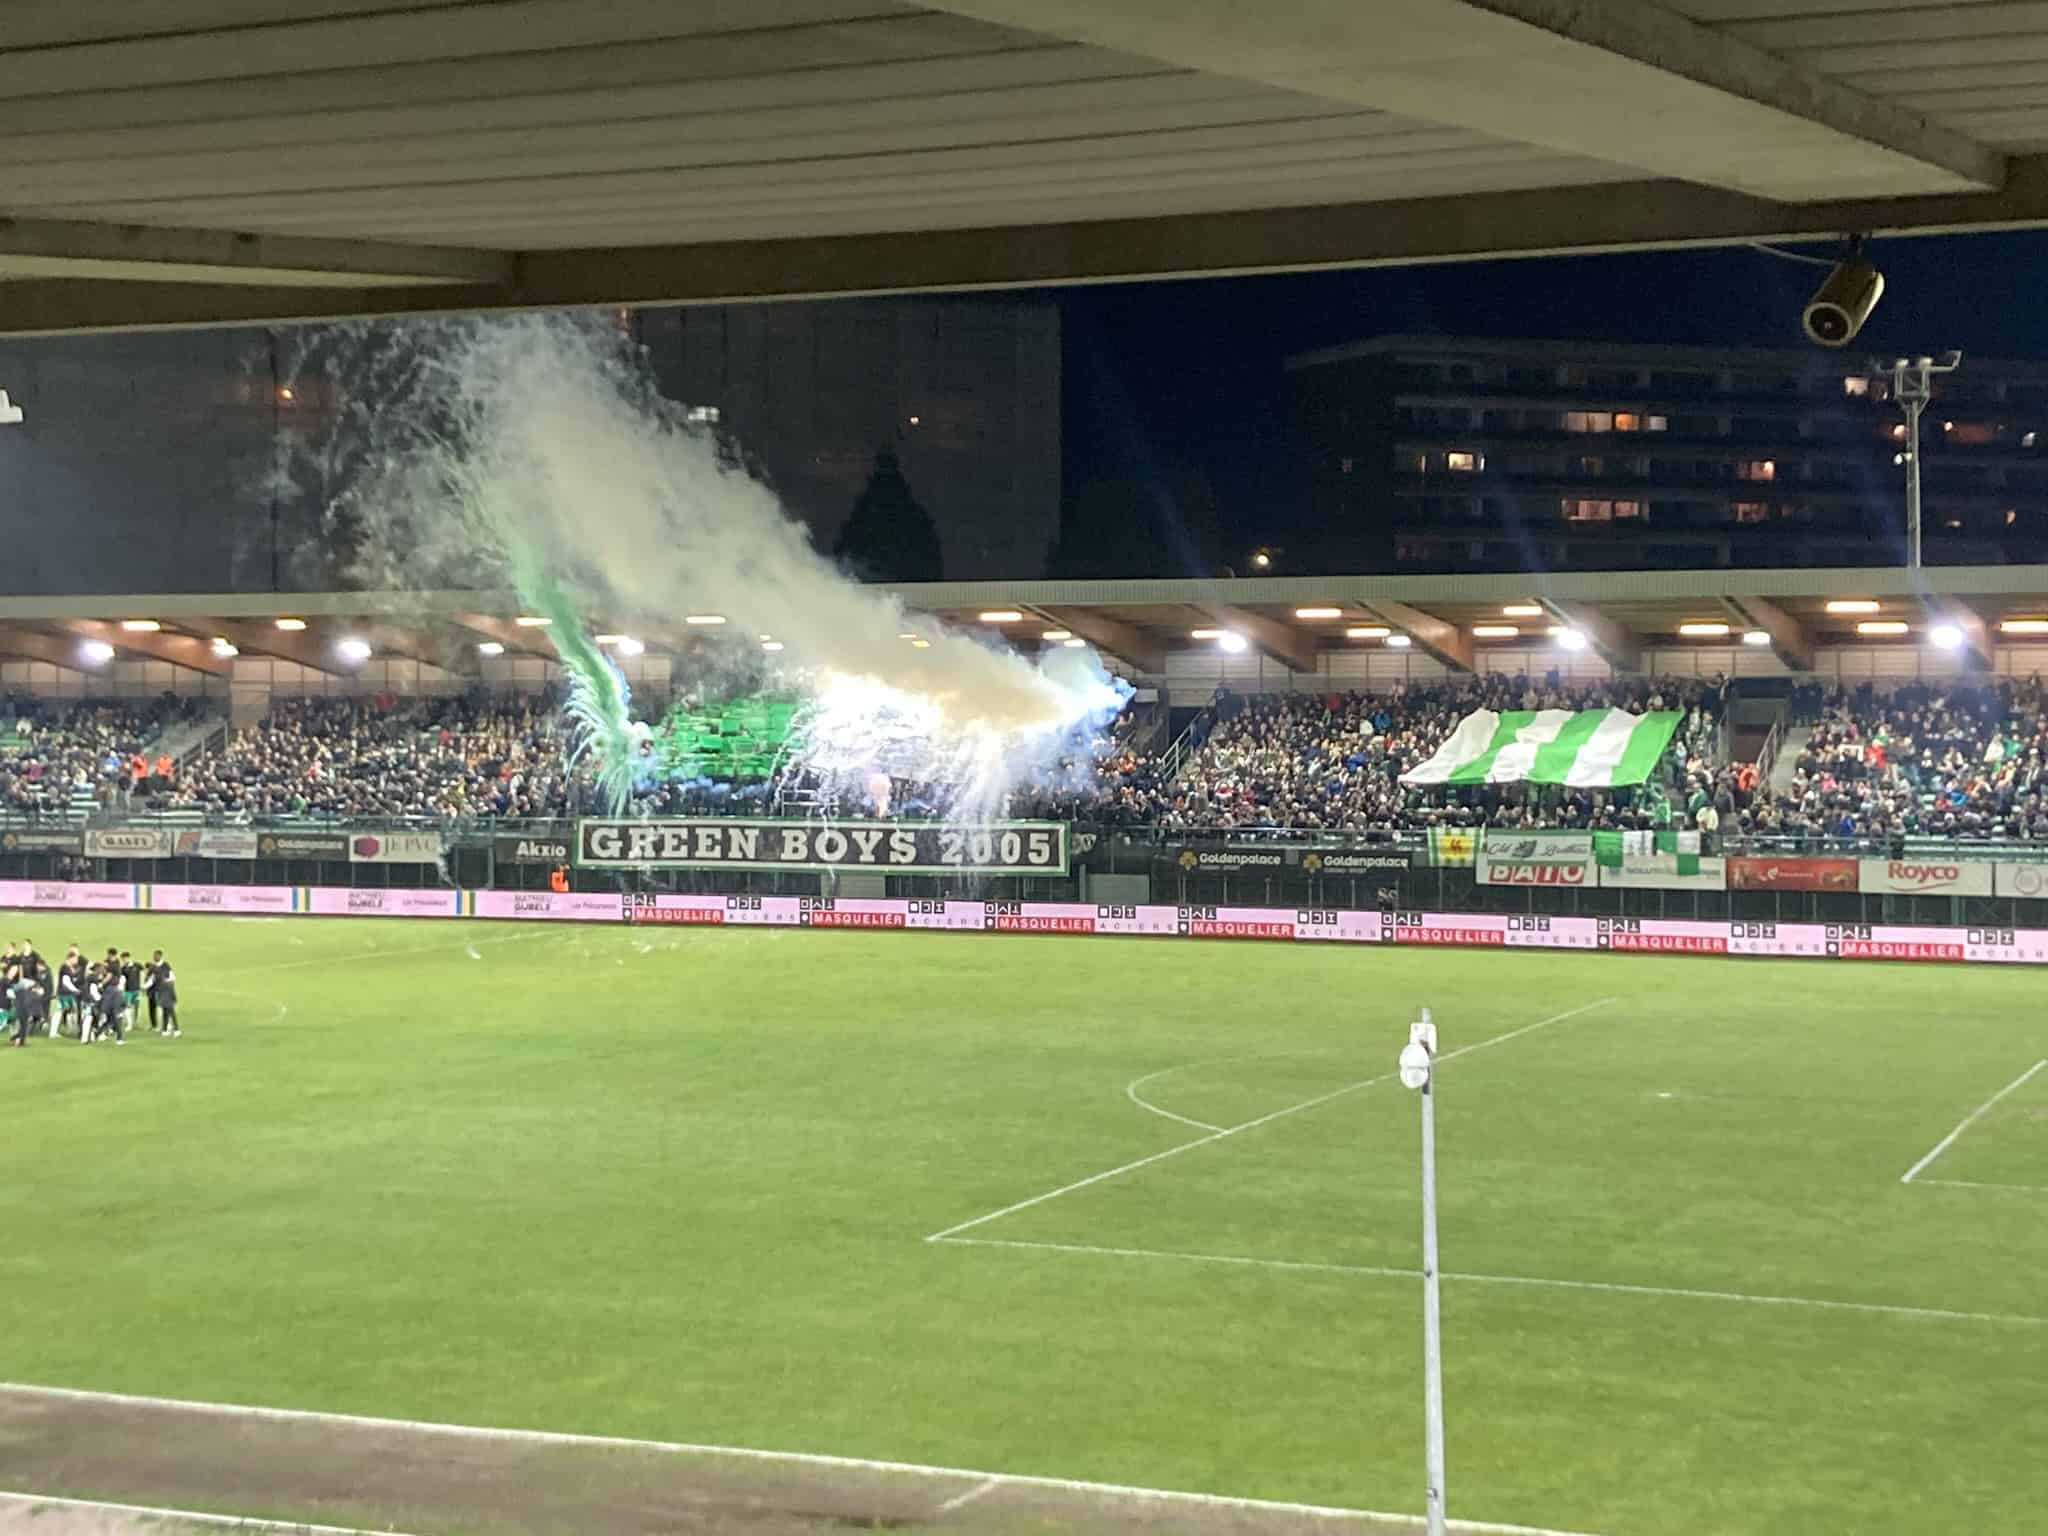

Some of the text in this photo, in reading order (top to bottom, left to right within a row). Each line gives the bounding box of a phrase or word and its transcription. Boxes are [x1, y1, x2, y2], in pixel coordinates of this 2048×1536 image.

[590, 827, 1050, 865] GREEN BOYS 2005
[1199, 853, 1281, 866] Goldenpalace
[1323, 855, 1409, 869] Goldenpalace
[1888, 862, 1959, 884] Royco
[636, 907, 722, 922] MASQUELIER
[813, 912, 904, 925] MASQUELIER
[1000, 917, 1093, 930] MASQUELIER
[1192, 922, 1292, 936] MASQUELIER
[1397, 928, 1502, 943] MASQUELIER
[1614, 935, 1725, 950] MASQUELIER
[1842, 942, 1960, 957] MASQUELIER
